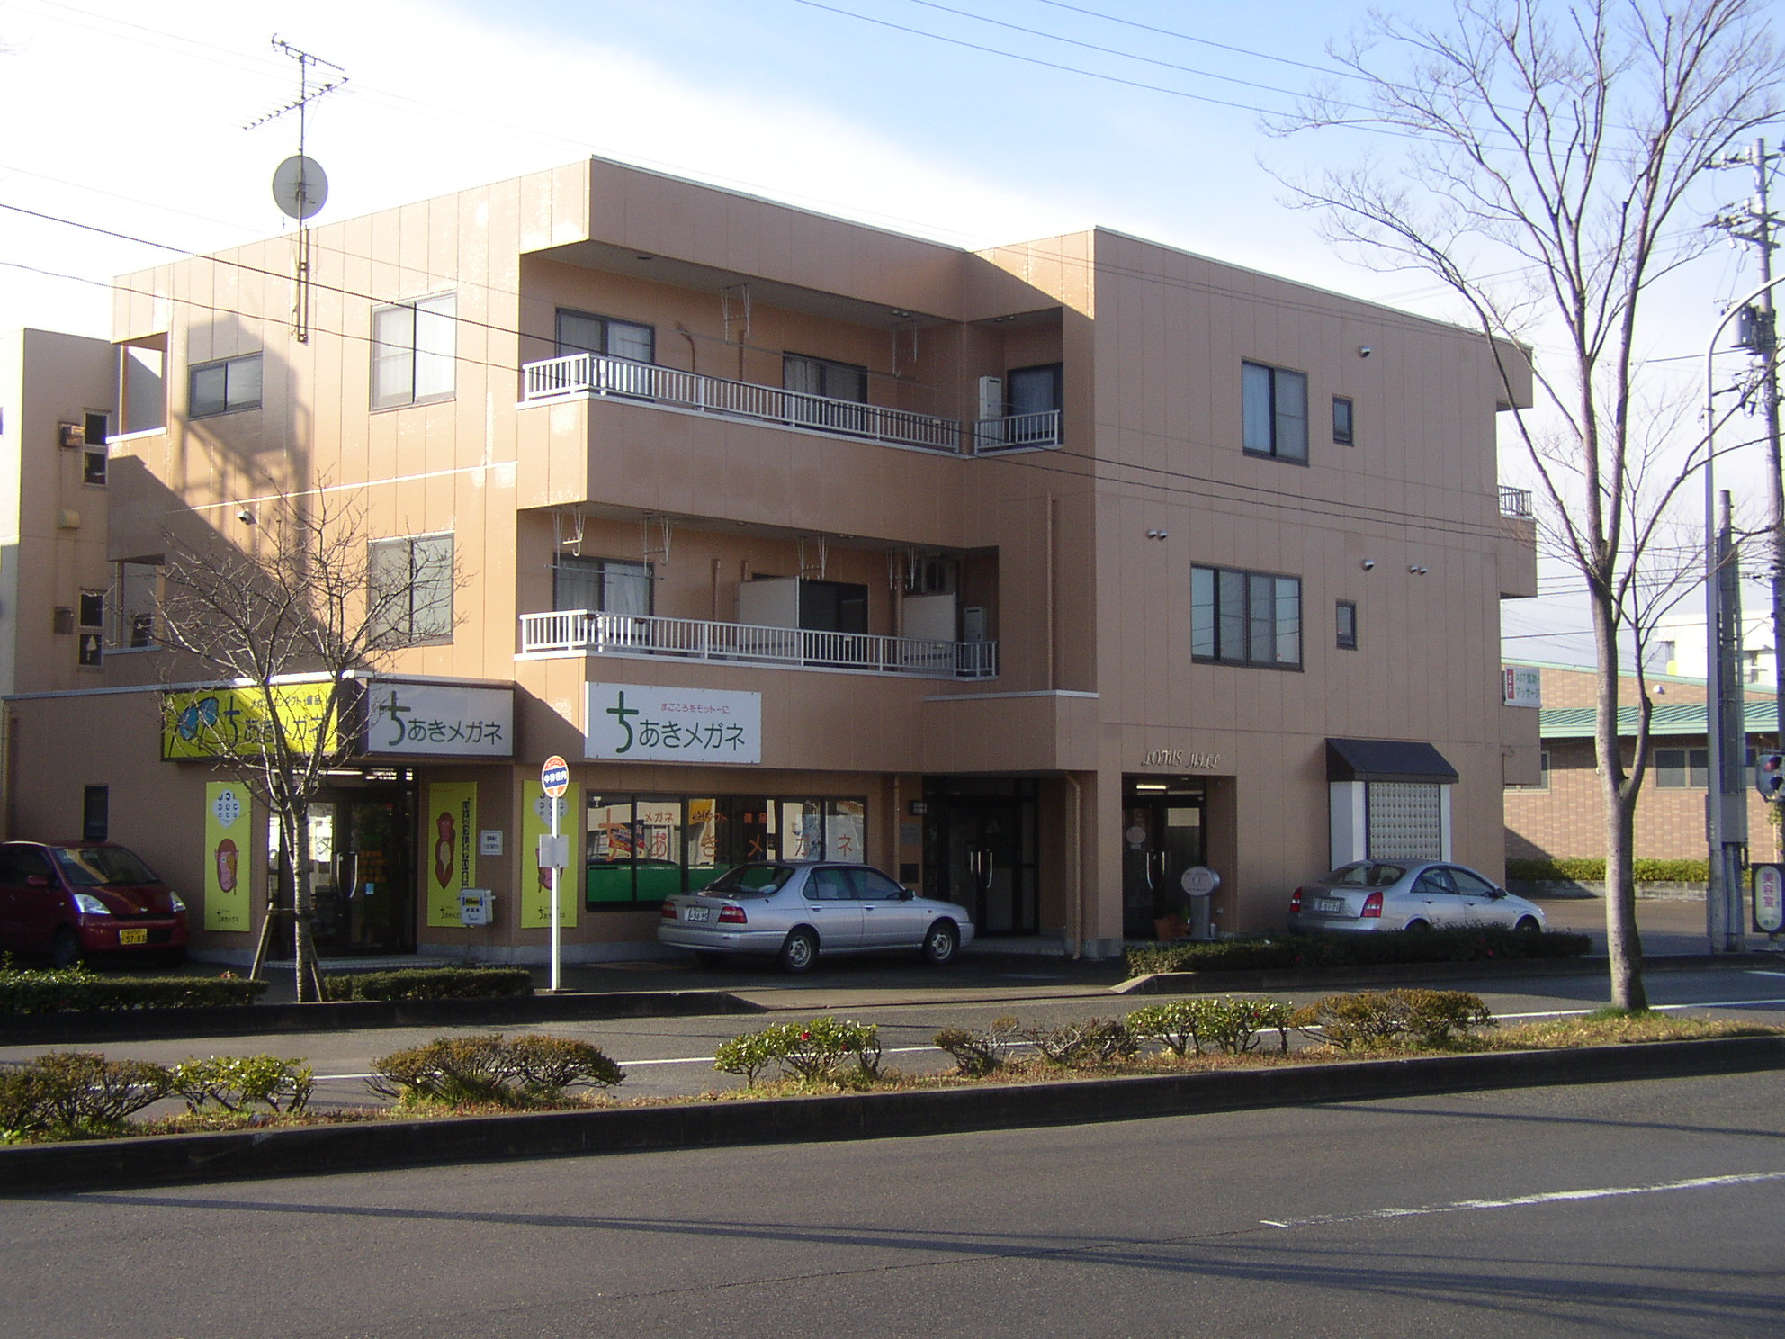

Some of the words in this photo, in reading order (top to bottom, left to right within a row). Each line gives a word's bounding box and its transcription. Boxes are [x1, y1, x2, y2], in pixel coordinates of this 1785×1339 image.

[379, 690, 503, 746] ちあきメガネ
[606, 690, 745, 754] ちあきメガネ
[645, 811, 673, 823] メガネ
